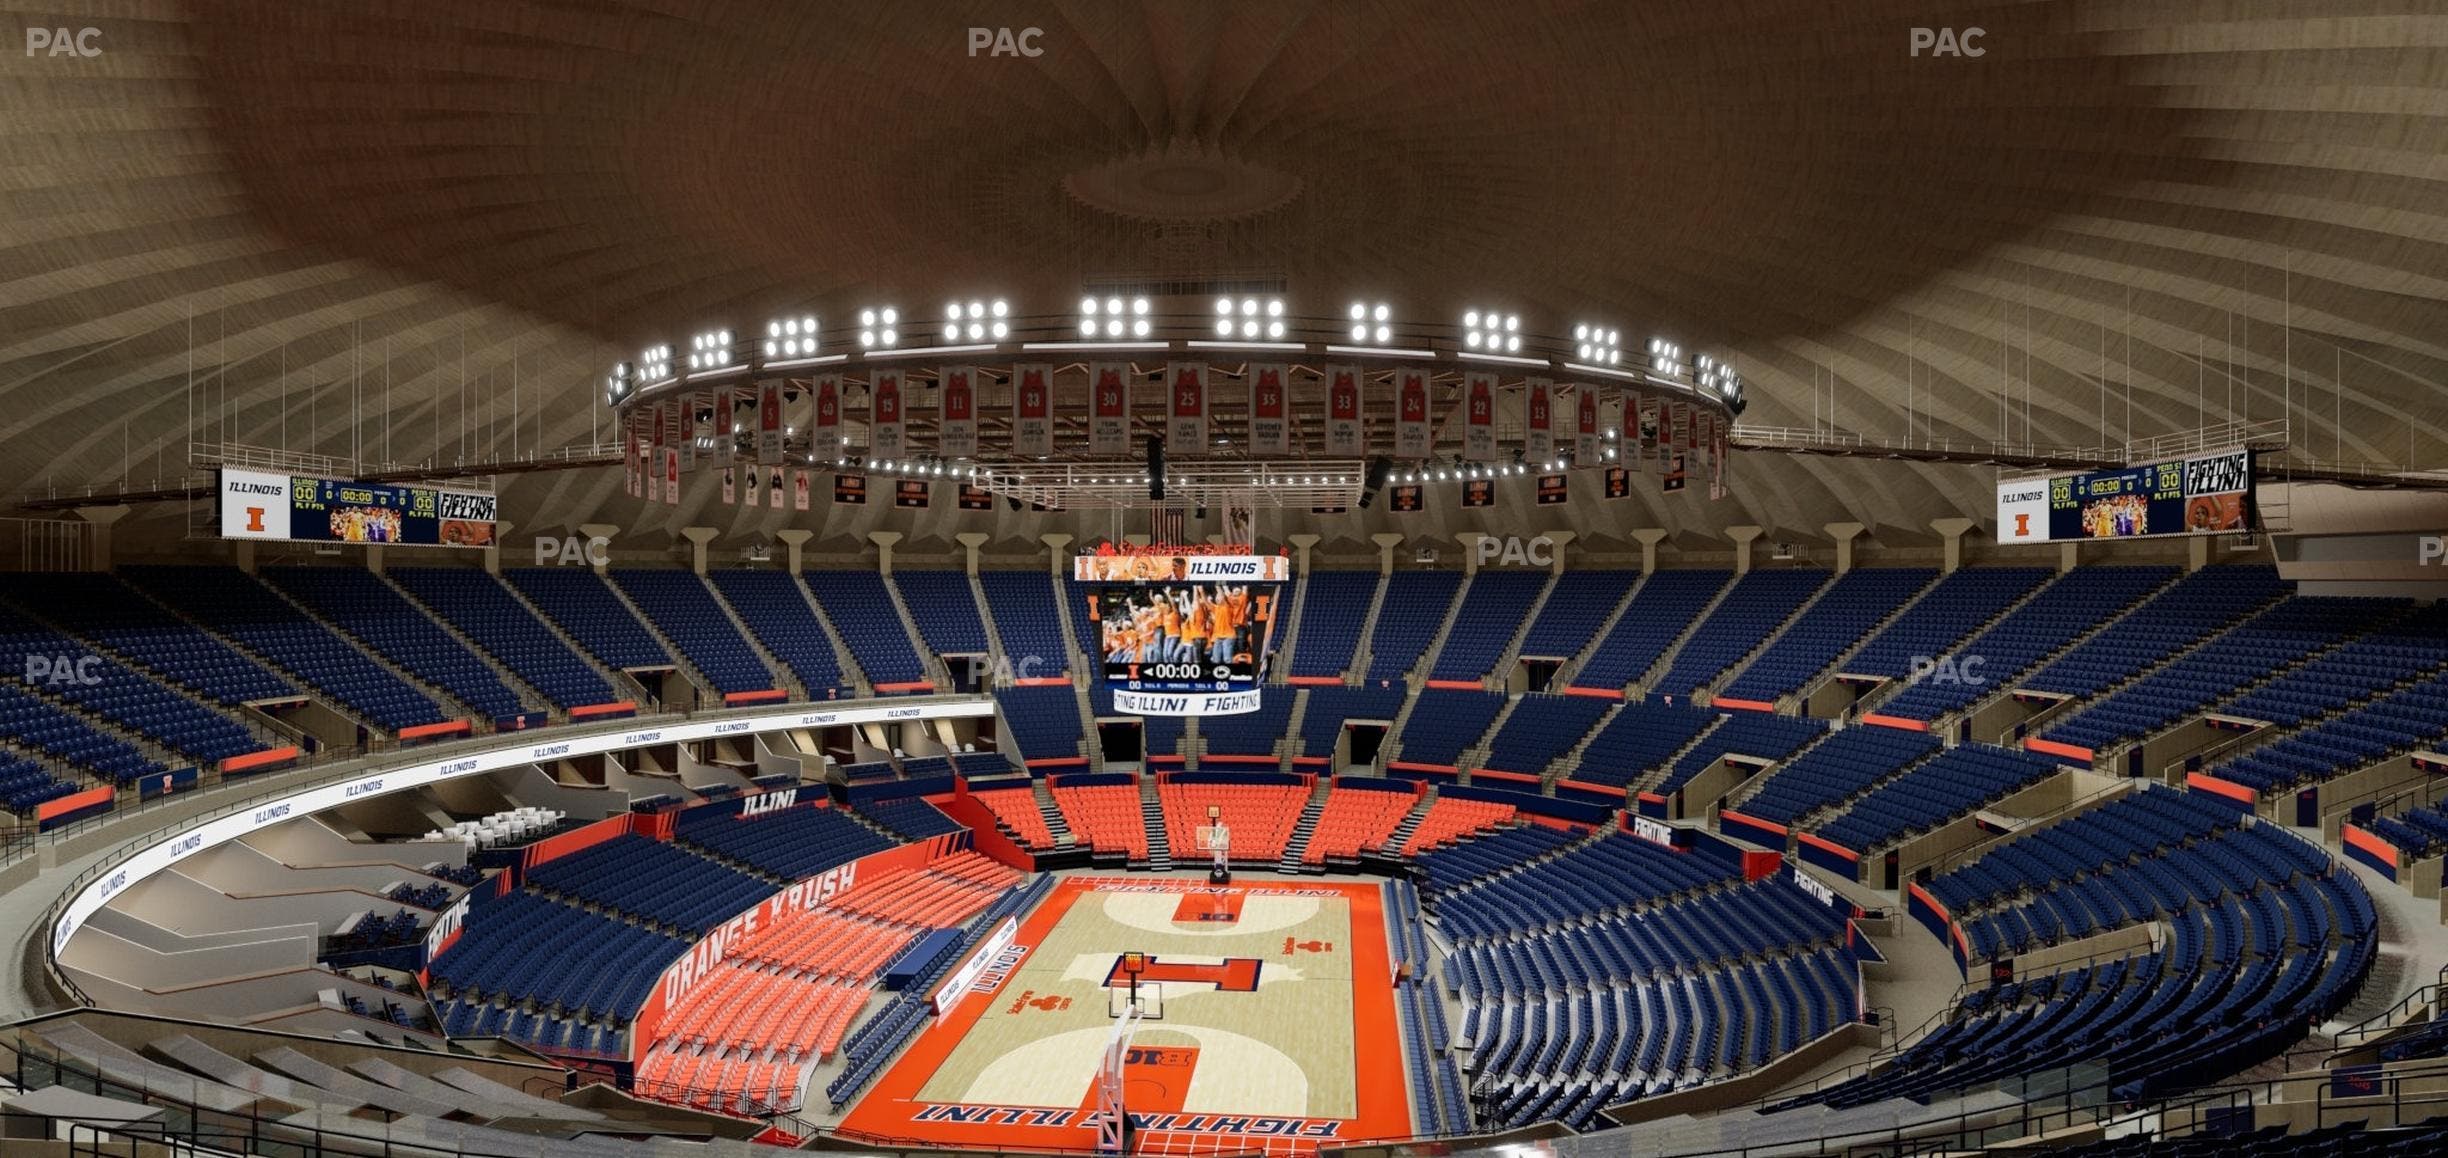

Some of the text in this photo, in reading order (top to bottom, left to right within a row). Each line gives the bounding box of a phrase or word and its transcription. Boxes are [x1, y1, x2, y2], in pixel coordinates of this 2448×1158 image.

[2187, 454, 2246, 480] FIGHTING
[2093, 480, 2119, 493] 00:00
[2161, 473, 2178, 487] 00
[229, 481, 283, 496] ILLINOIS
[295, 487, 314, 501] 00
[2053, 486, 2068, 500] 00
[342, 491, 371, 502] 00:00
[416, 498, 433, 509] 00
[441, 494, 495, 511] FIGHTING
[2002, 491, 2043, 503] ILLINOIS
[1190, 563, 1256, 574] ILLINOIS
[1155, 664, 1200, 679] 00:00
[1129, 682, 1141, 690] 00
[1216, 682, 1229, 691] 00
[1138, 696, 1188, 712] ILLINI
[801, 714, 837, 725] ILLINOIS
[887, 708, 921, 718] ILLINOIS
[715, 721, 751, 733] ILLINOIS
[626, 732, 661, 744] ILLINOIS
[534, 744, 569, 758] ILLINOIS
[440, 759, 477, 776] ILLINOIS
[345, 779, 383, 797] ILLINOIS
[743, 789, 797, 816] ILLINI
[255, 803, 290, 825] ILLINOIS
[1634, 816, 1672, 846] FIGHTING
[170, 833, 202, 859] ILLINOIS
[1794, 869, 1833, 907] FIGHTING
[665, 861, 857, 1011] ORANGE KRUSH
[970, 945, 1030, 993] ILLINOIS
